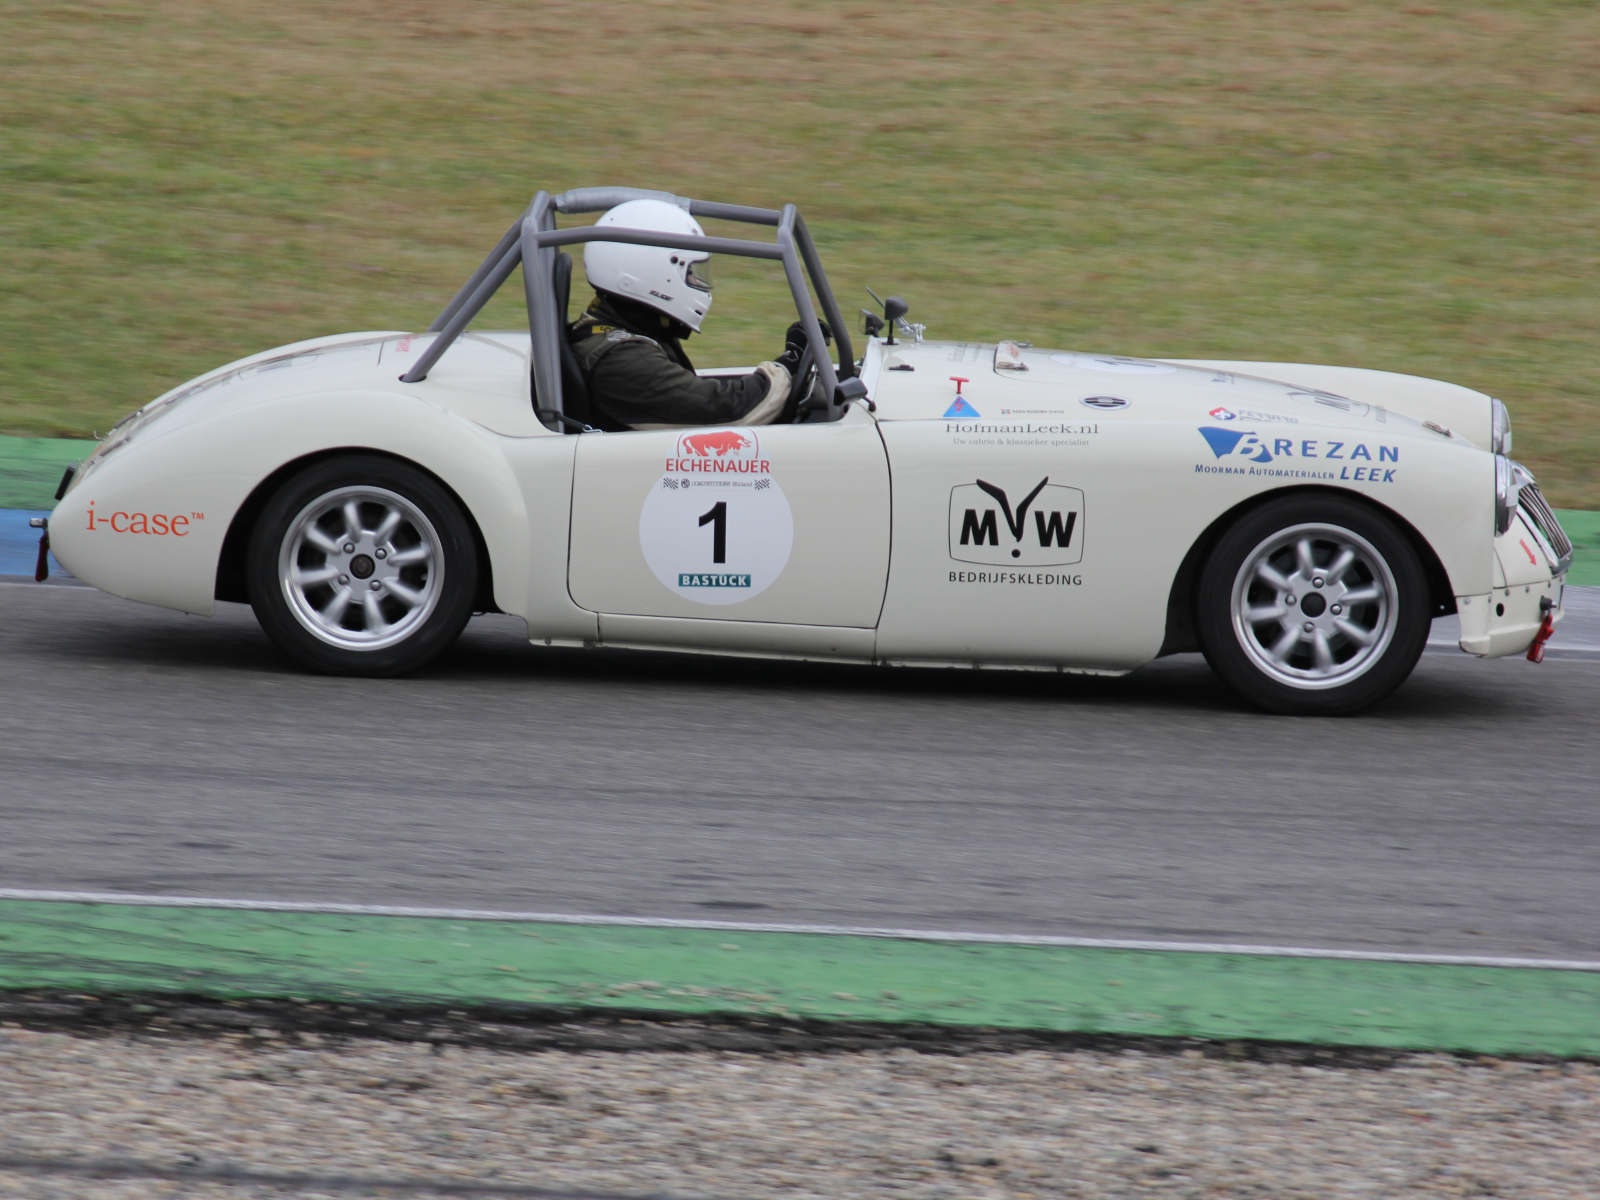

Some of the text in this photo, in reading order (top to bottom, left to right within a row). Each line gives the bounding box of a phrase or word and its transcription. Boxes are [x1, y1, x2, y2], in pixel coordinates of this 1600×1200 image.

[945, 422, 1099, 435] HofmanLeek.nl
[953, 437, 1090, 448] Uw cabrio & klassieker specialist
[665, 458, 771, 474] EICHENAUER
[1339, 465, 1398, 484] LEEK
[698, 501, 727, 564] 1
[948, 571, 1083, 586] BEDRIJFSKLEDING
